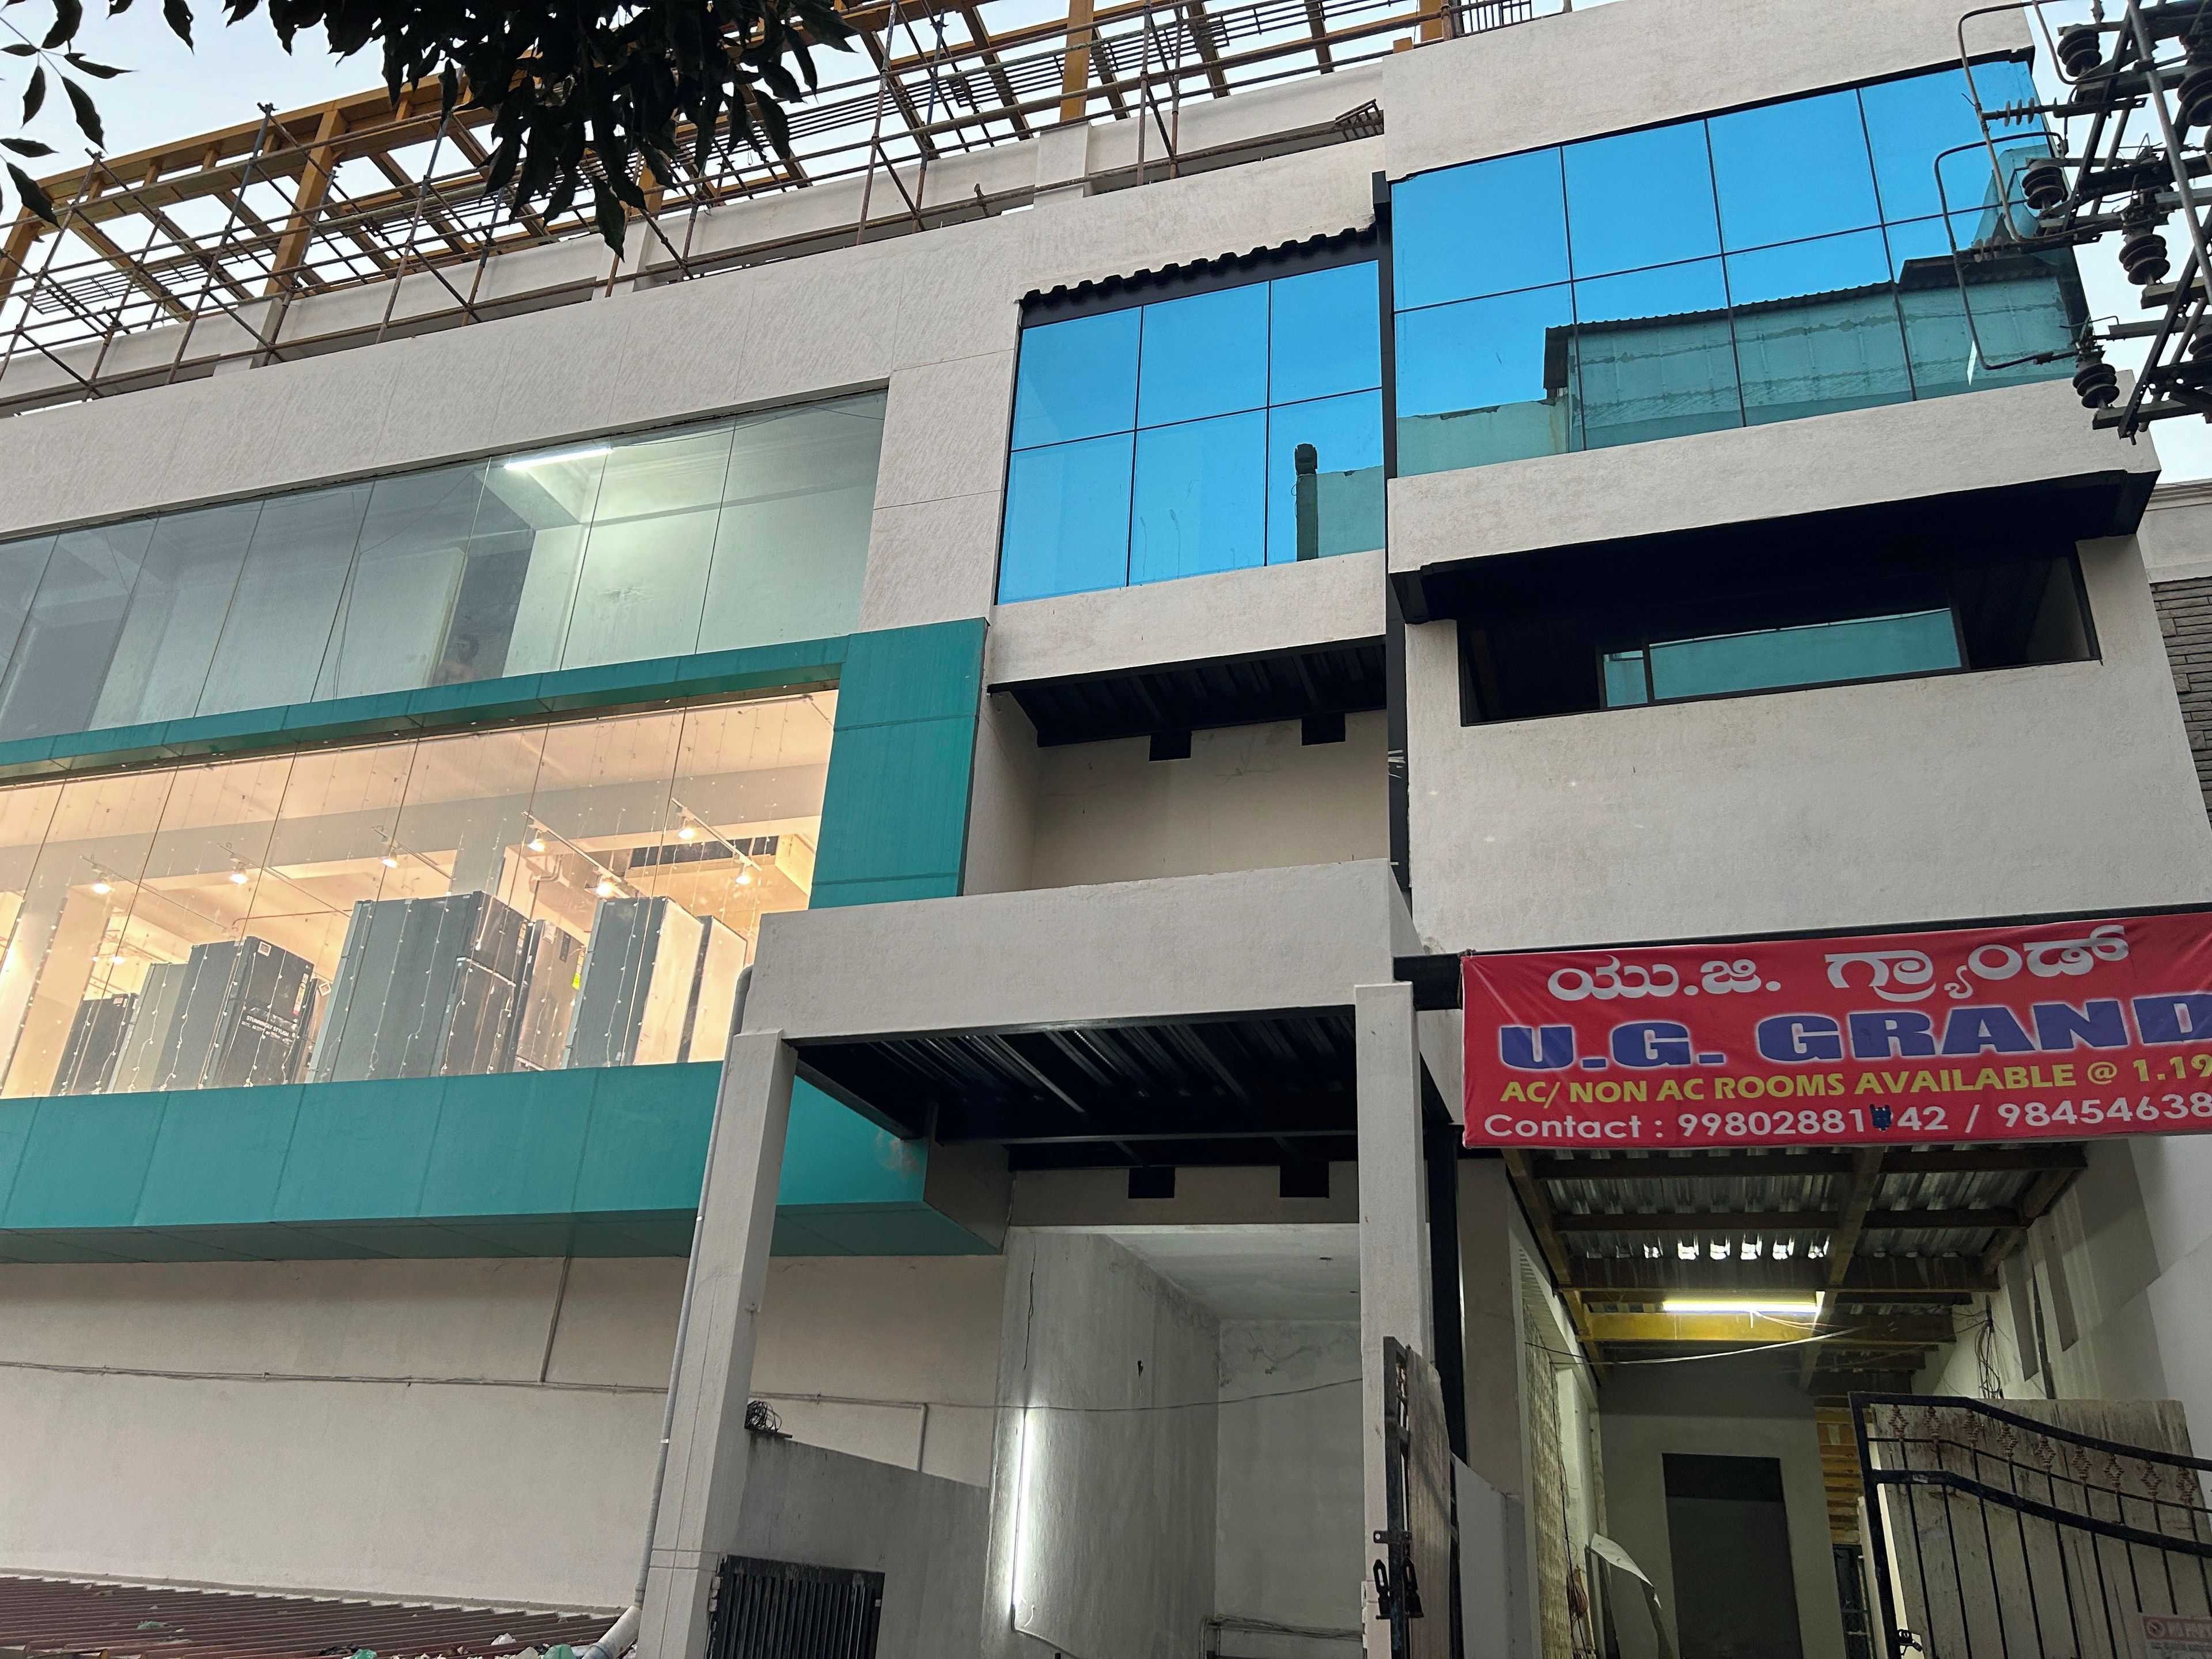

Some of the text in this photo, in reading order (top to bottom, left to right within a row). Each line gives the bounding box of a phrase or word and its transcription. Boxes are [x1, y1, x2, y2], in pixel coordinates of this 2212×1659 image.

[1548, 954, 1781, 1001] ಯು.ಜಿ.
[1499, 991, 2212, 1071] U.G. GRAND
[1500, 1081, 1559, 1108] AC/
[1570, 1080, 1647, 1103] NON
[1656, 1078, 1704, 1101] AC
[1714, 1073, 1844, 1099] ROOMS
[1854, 1064, 2076, 1094] AVAILABLE
[2086, 1061, 2118, 1085] @
[1484, 1114, 1641, 1138] Contact
[1997, 1092, 2212, 1127] 98454638
